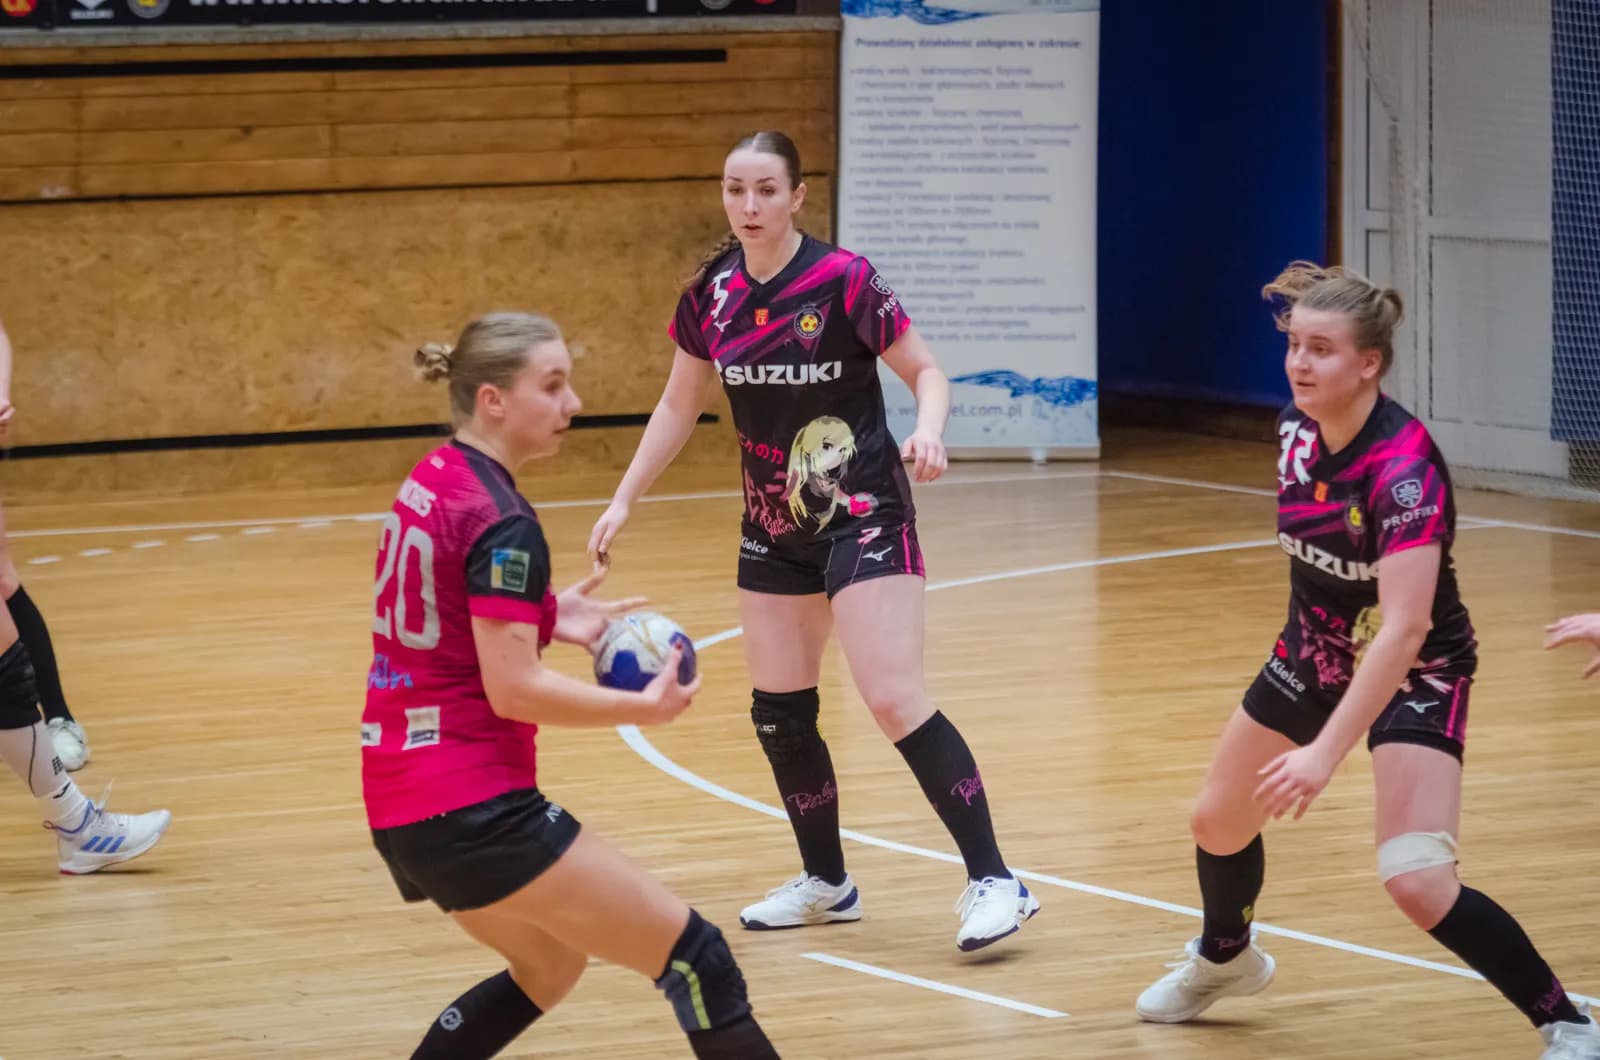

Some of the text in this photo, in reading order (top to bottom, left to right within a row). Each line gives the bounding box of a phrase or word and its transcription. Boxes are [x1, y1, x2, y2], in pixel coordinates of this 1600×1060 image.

[725, 360, 842, 386] SUZUKI
[1278, 531, 1379, 582] SUZUK
[372, 511, 441, 651] 20
[1270, 657, 1306, 693] Kielce
